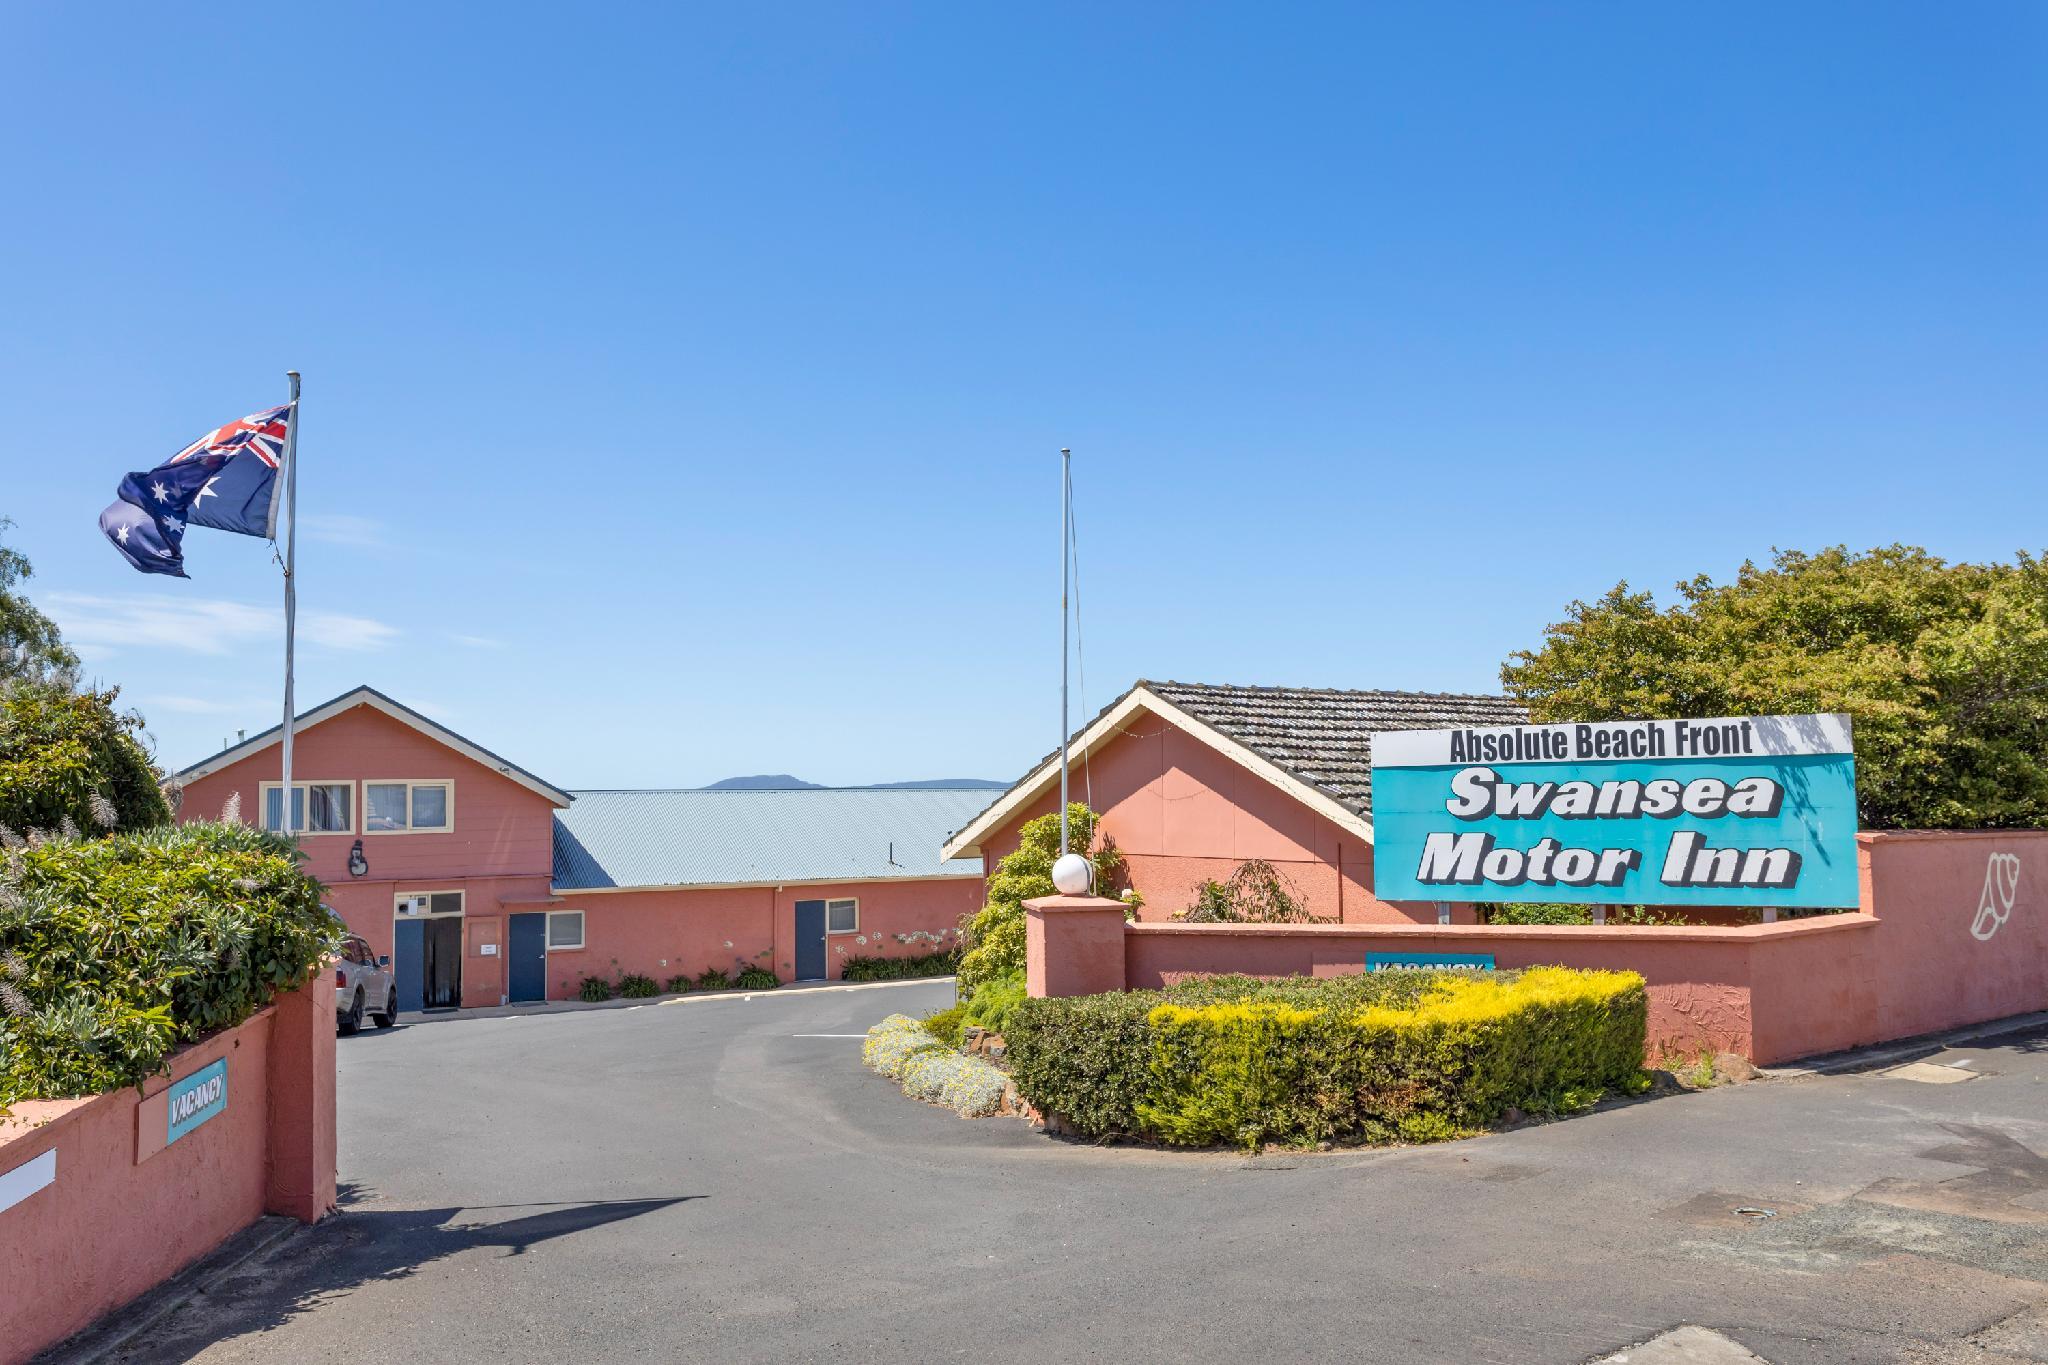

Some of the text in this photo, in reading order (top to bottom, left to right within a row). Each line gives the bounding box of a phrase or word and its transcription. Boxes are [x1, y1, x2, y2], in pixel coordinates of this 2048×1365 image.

[1450, 720, 1753, 763] Absolute Beach Front
[1446, 767, 1785, 821] Swansea
[1416, 831, 1802, 889] Motor Inn
[172, 1073, 224, 1128] VACANCY
